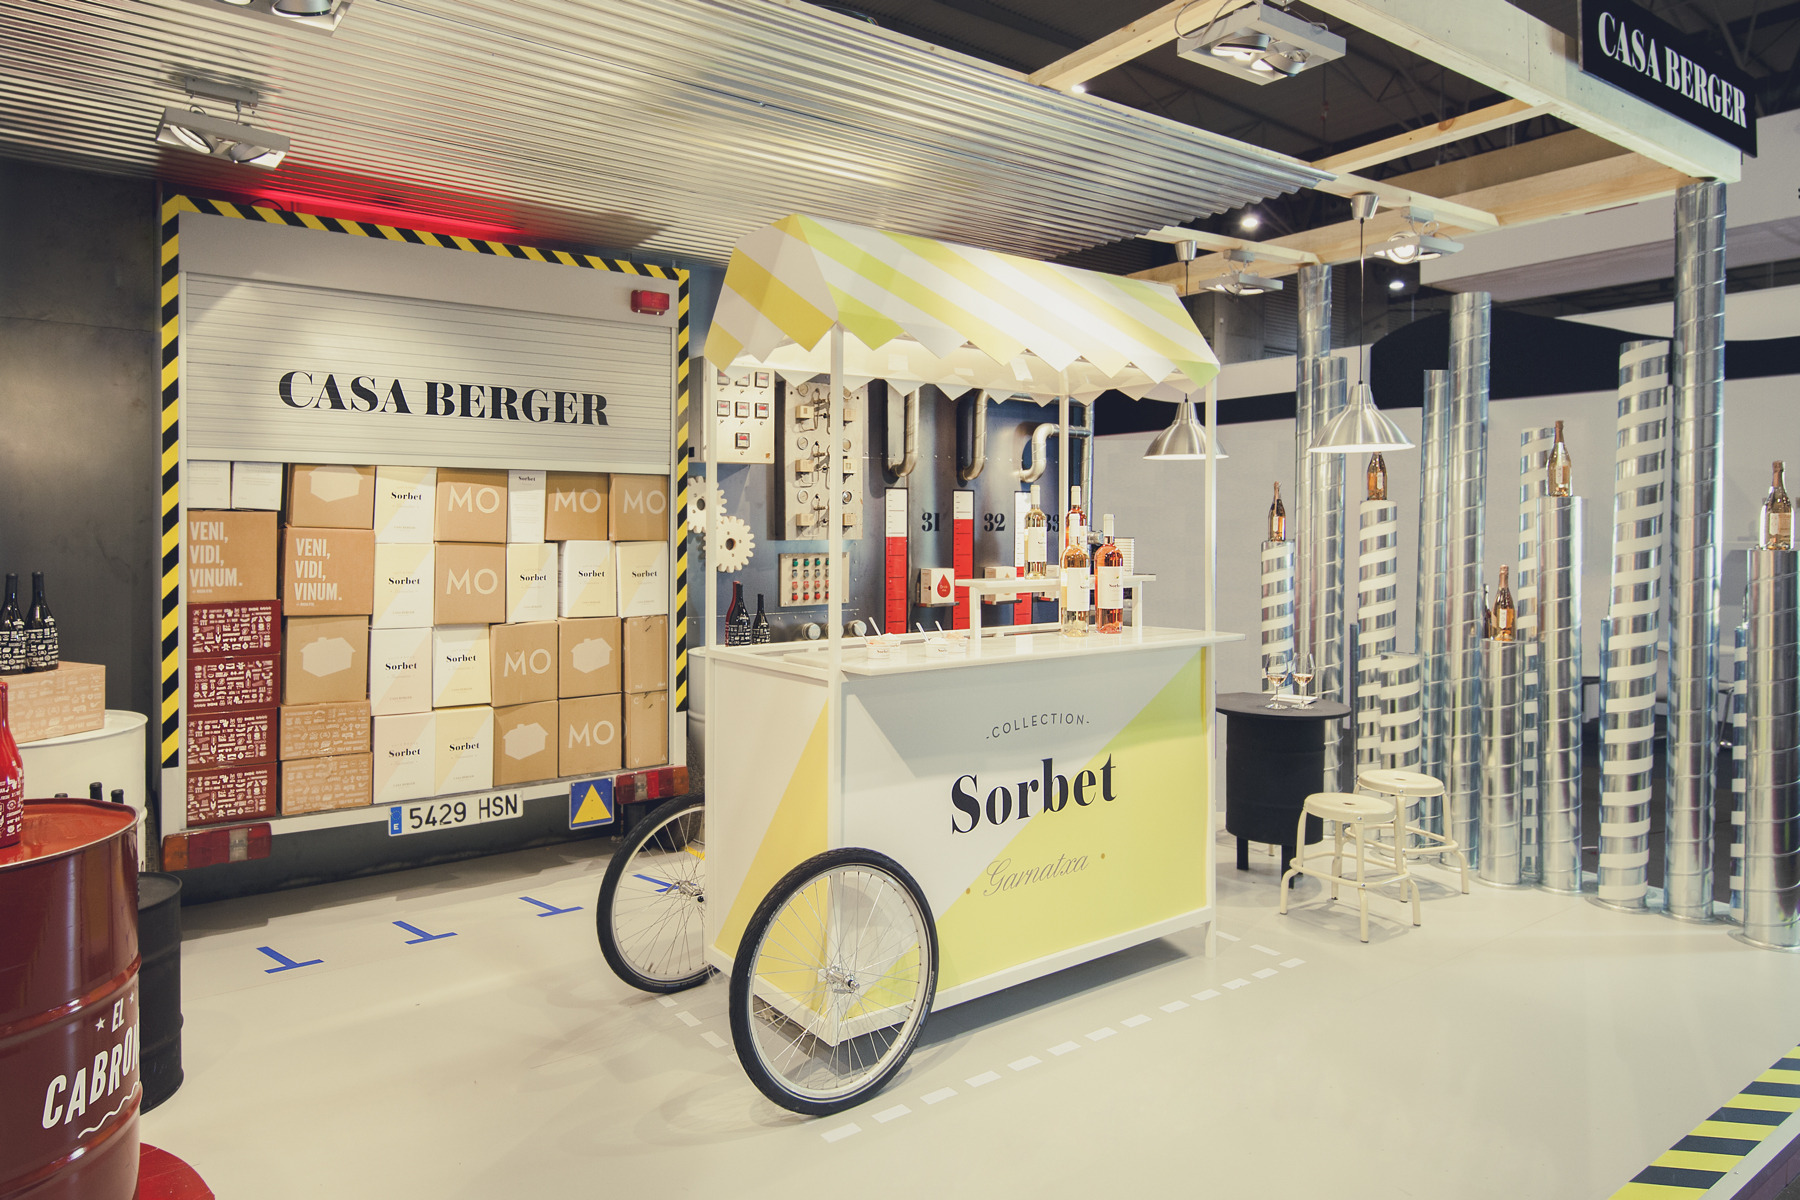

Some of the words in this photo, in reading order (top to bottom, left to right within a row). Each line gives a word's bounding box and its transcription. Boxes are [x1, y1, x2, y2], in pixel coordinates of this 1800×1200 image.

[1598, 12, 1662, 83] CASA
[1664, 46, 1747, 129] BERGER
[278, 371, 413, 414] CASA
[425, 381, 609, 426] BERGER
[391, 491, 422, 501] Sorbet
[448, 486, 500, 514] MO
[553, 487, 602, 513] MO
[623, 489, 667, 515] MO
[190, 521, 229, 544] VENI,
[921, 512, 940, 533] 31
[983, 512, 1006, 532] 32
[190, 545, 225, 568] VIDI,
[295, 537, 331, 560] VENI,
[189, 567, 244, 588] VINUM.
[294, 560, 327, 582] VIDI,
[389, 576, 420, 585] Sorbet
[446, 568, 498, 595] MO
[519, 573, 547, 581] Sorbet
[578, 569, 606, 578] Sorbet
[631, 569, 658, 578] Sorbet
[294, 582, 343, 601] VINUM.
[385, 661, 418, 671] Sorbet
[446, 654, 477, 662] Sorbet
[503, 648, 551, 678] MO
[568, 720, 615, 749] MO
[388, 748, 421, 758] Sorbet
[449, 742, 480, 751] Sorbet
[951, 753, 1118, 835] Sorbet
[409, 801, 467, 829] 5429
[478, 793, 517, 820] HSN
[393, 823, 399, 831] E
[983, 853, 1089, 897] Garnatxa
[111, 997, 125, 1033] EL
